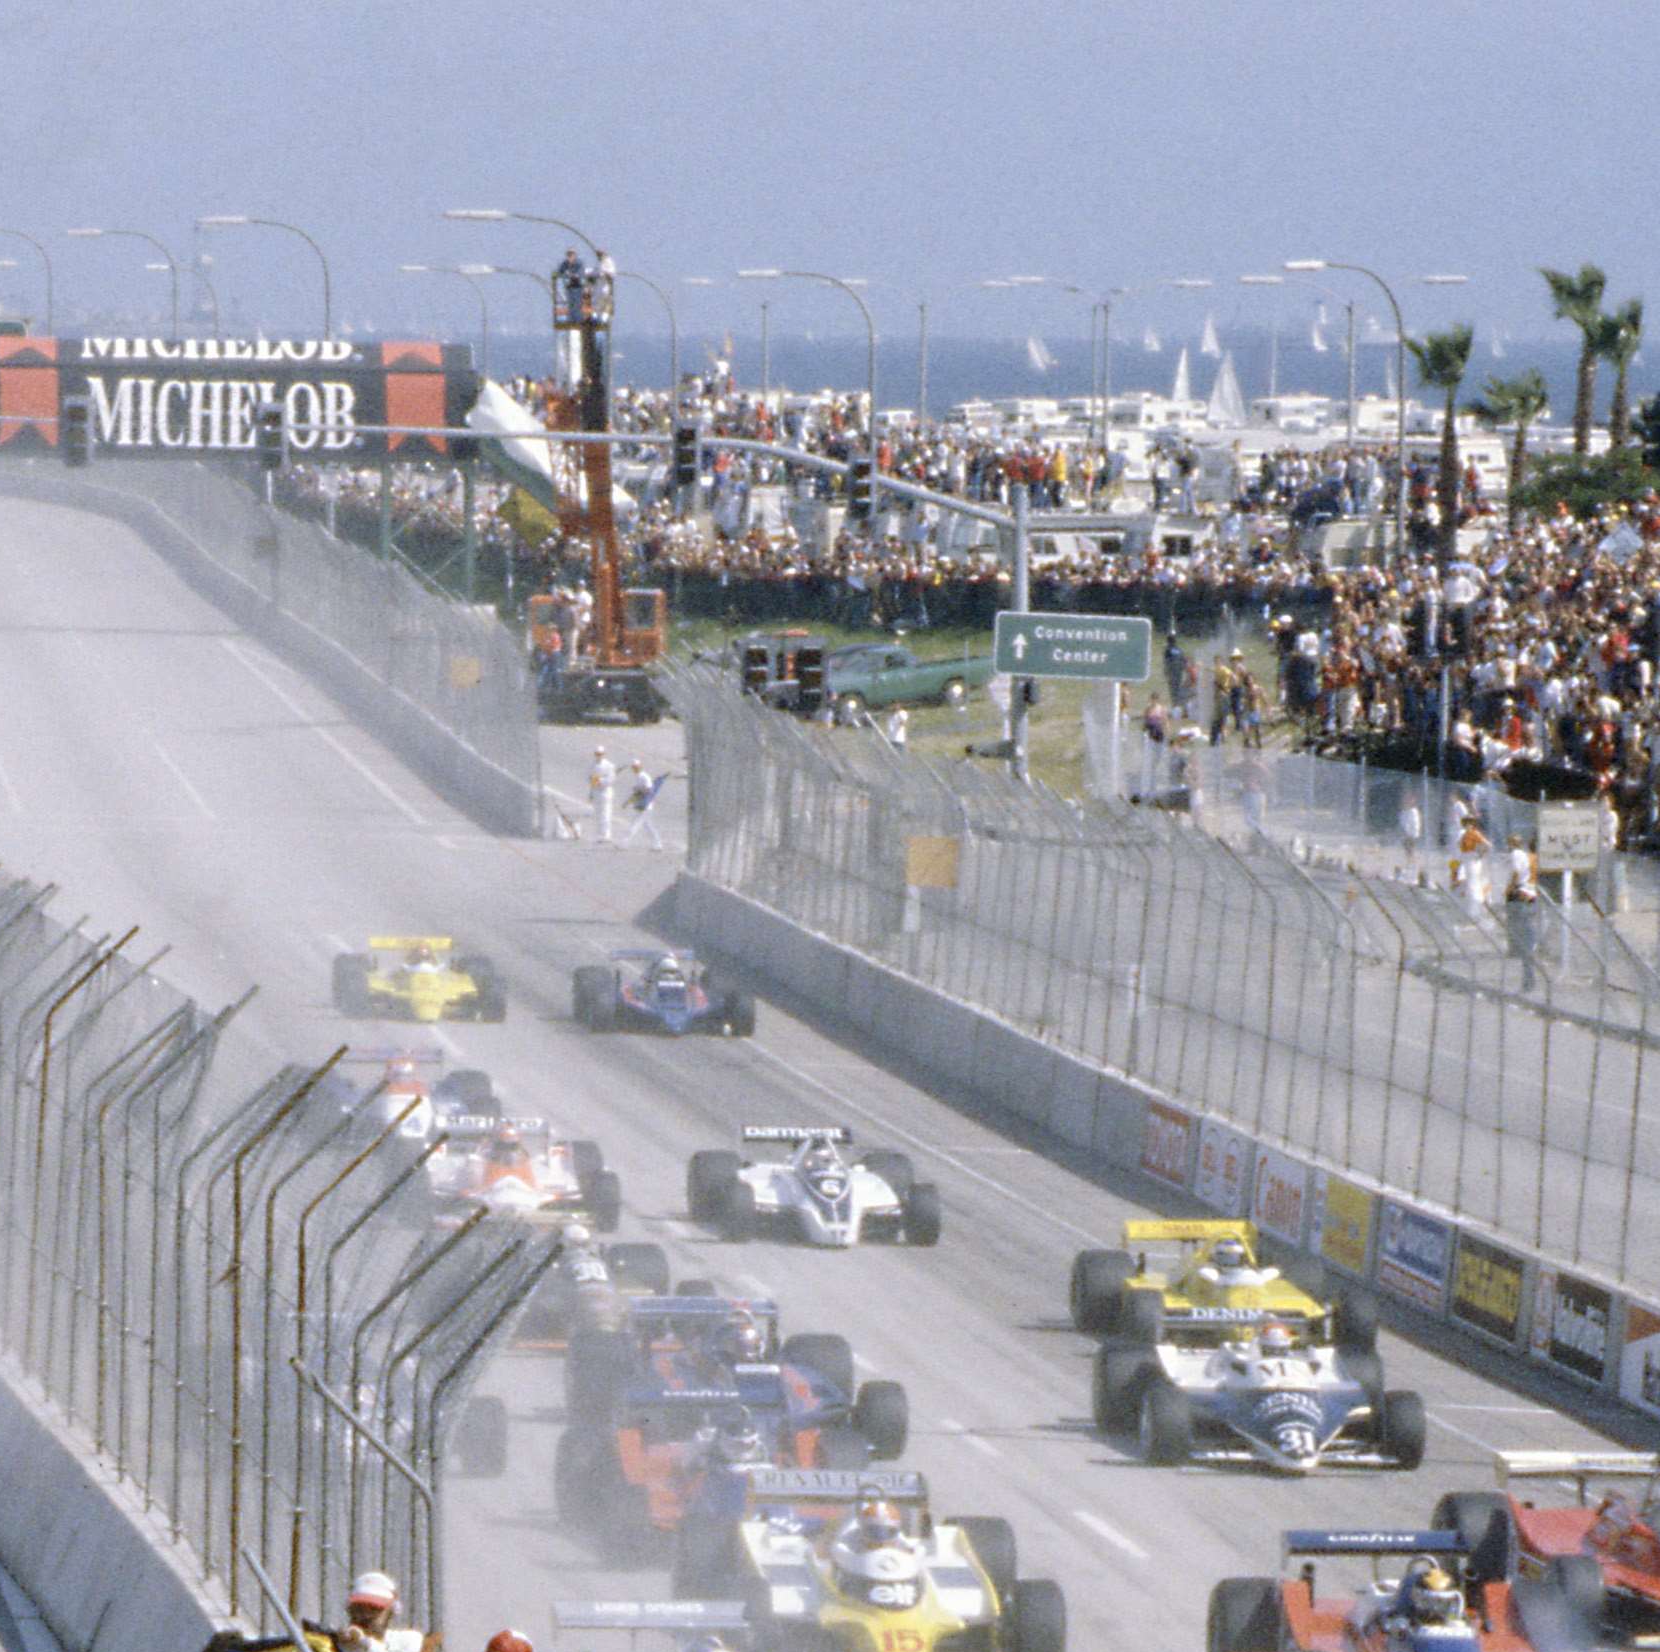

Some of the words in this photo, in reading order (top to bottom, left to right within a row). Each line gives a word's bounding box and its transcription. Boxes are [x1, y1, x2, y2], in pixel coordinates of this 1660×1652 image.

[1034, 625, 1128, 641] Convention
[1052, 648, 1108, 662] Center
[870, 1583, 918, 1606] elf
[883, 1629, 925, 1652] 15
